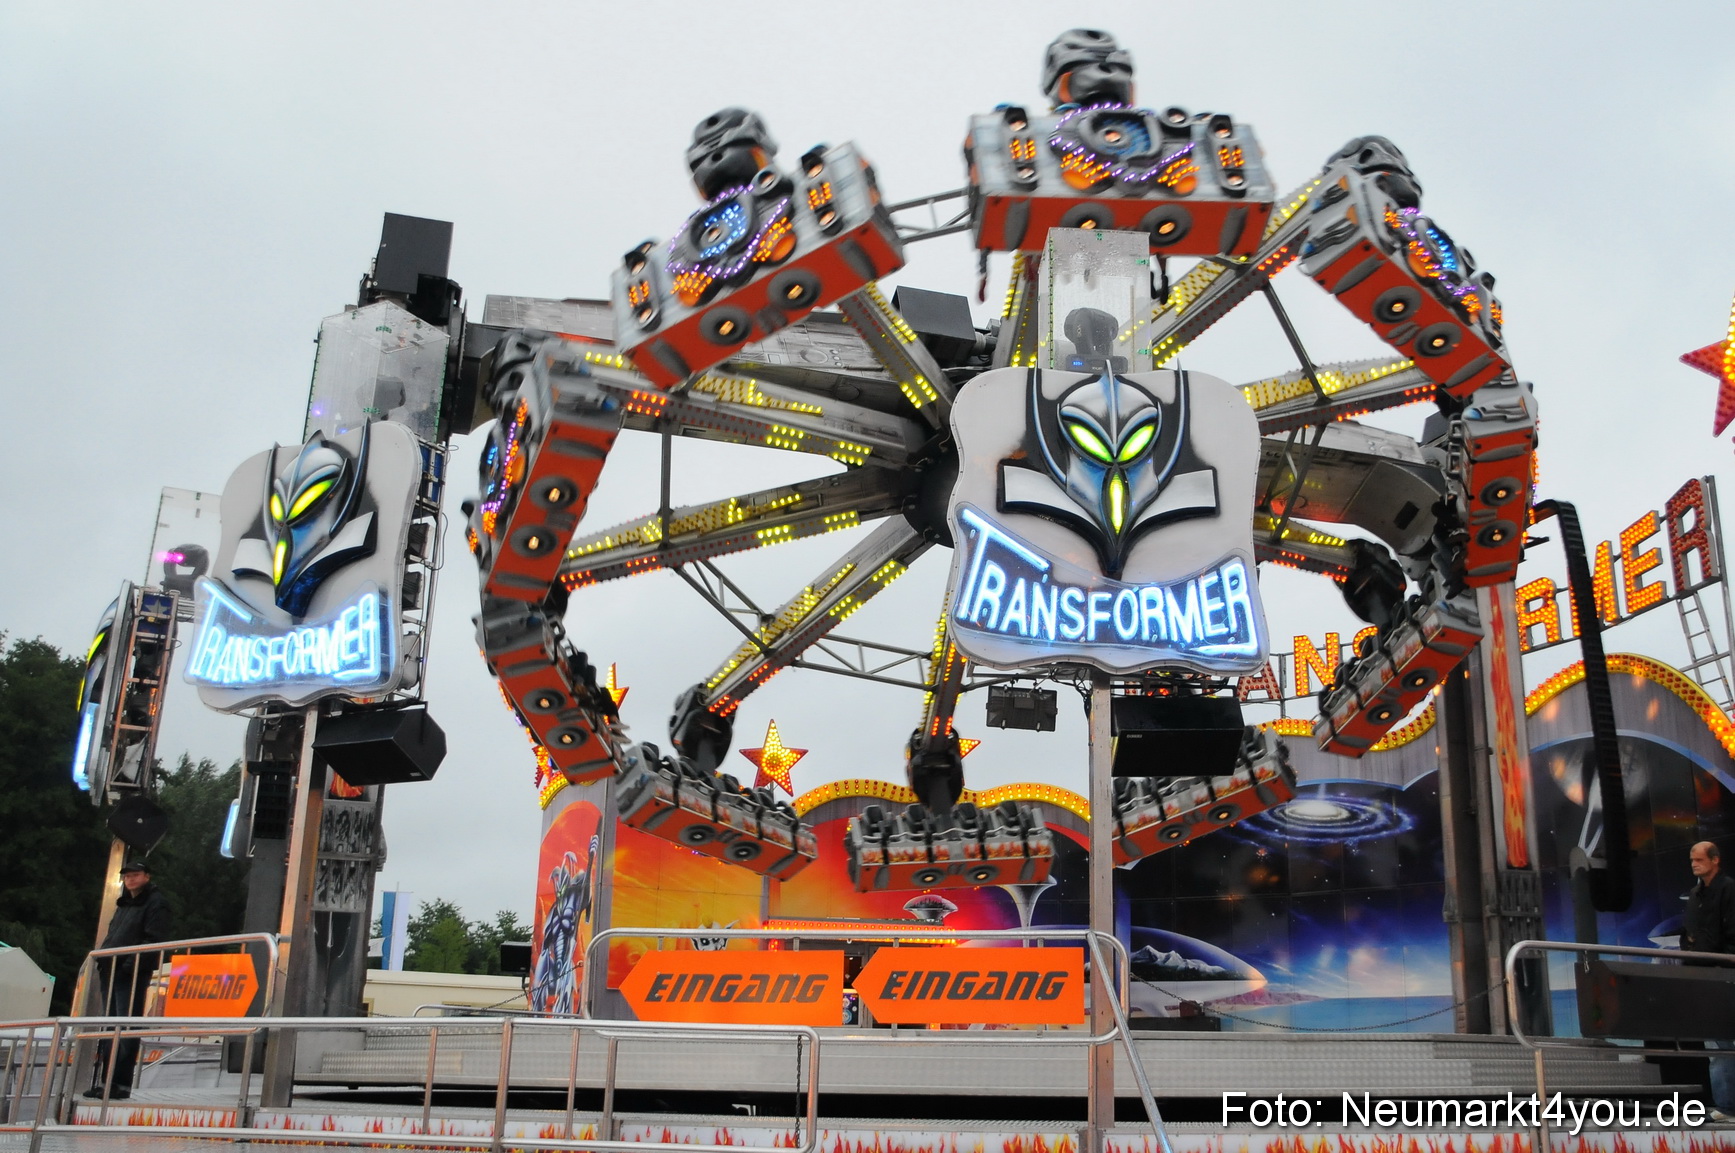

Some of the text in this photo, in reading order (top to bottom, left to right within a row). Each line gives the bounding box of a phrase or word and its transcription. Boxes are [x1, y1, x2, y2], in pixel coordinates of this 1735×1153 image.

[957, 508, 1258, 654] TRANSFORMER
[190, 582, 379, 684] TRANSFORMER
[173, 975, 248, 1000] EINGANG
[645, 974, 829, 1003] EINGANG
[879, 971, 1069, 1001] EINGANG
